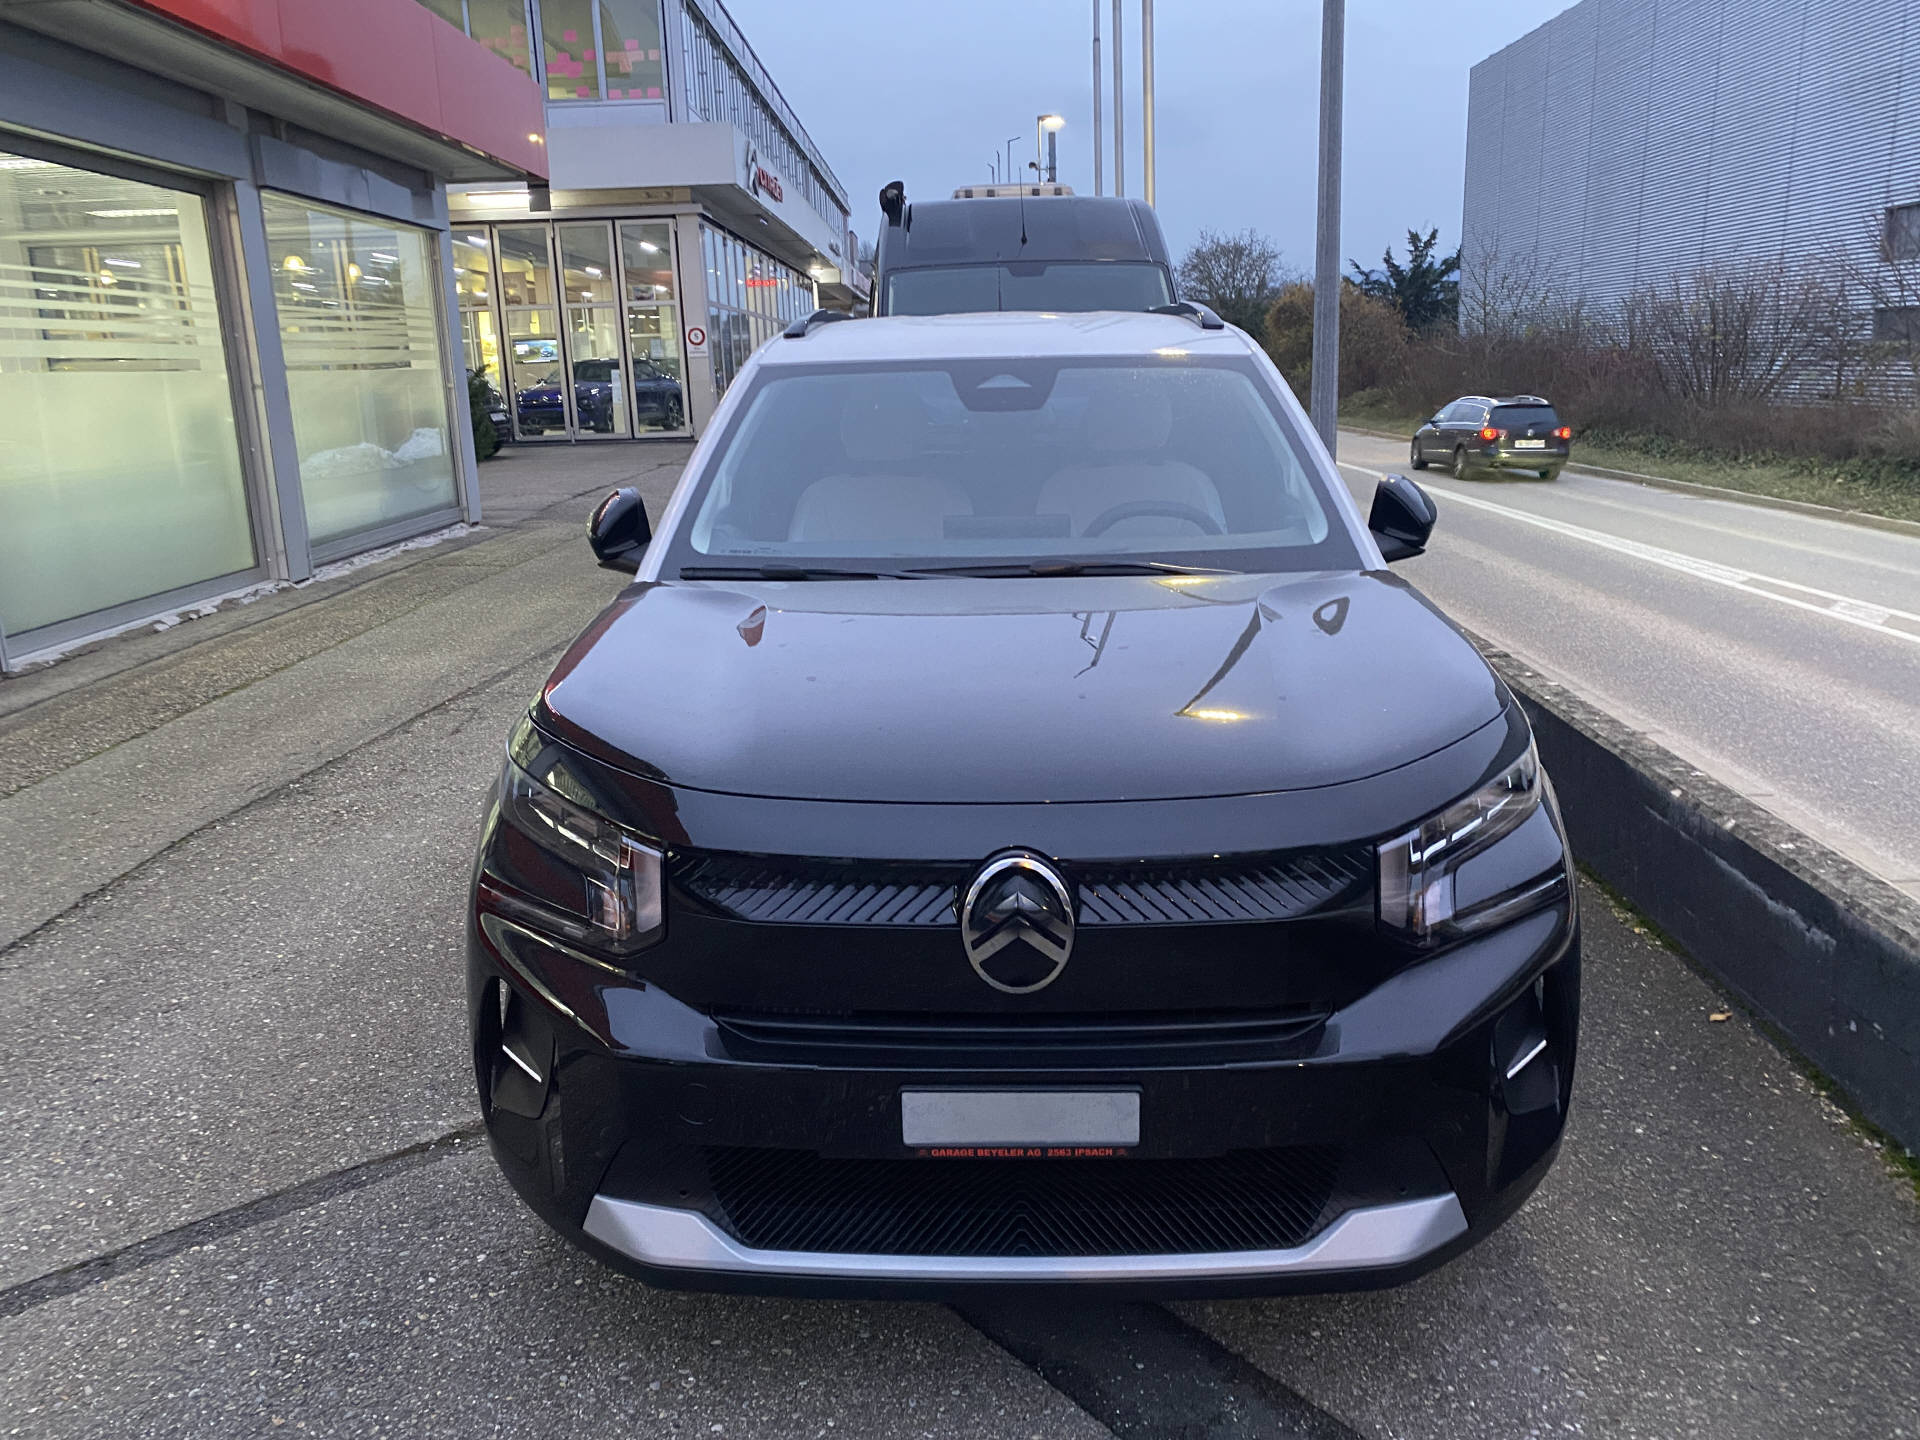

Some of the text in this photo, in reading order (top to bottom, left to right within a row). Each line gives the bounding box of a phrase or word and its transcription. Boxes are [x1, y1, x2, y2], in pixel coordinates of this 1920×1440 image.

[931, 1148, 975, 1157] GARAGE
[977, 1148, 1024, 1157] BEYELER
[1027, 1148, 1042, 1157] AG
